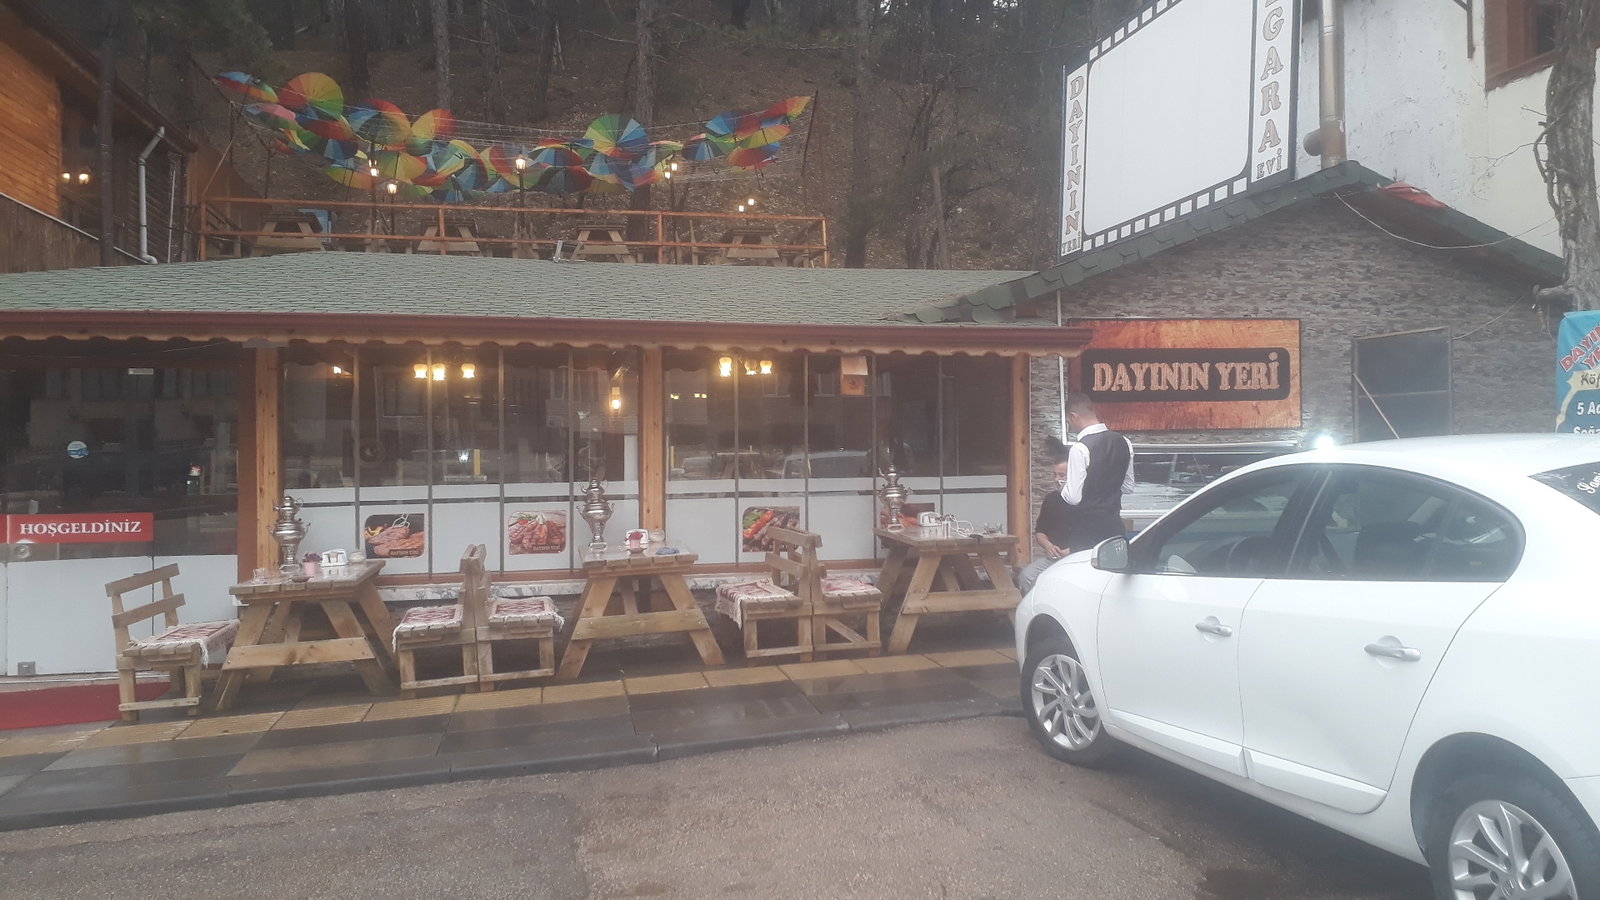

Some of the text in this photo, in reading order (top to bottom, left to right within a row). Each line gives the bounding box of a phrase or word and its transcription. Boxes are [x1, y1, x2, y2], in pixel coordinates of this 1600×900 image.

[1257, 0, 1284, 153] GARA
[1065, 75, 1084, 236] DAYININ
[1256, 148, 1283, 179] EVİ
[1092, 351, 1280, 392] DAYININ YERİ
[1576, 401, 1584, 416] 5
[19, 518, 142, 537] HOŞGELDİNİZ
